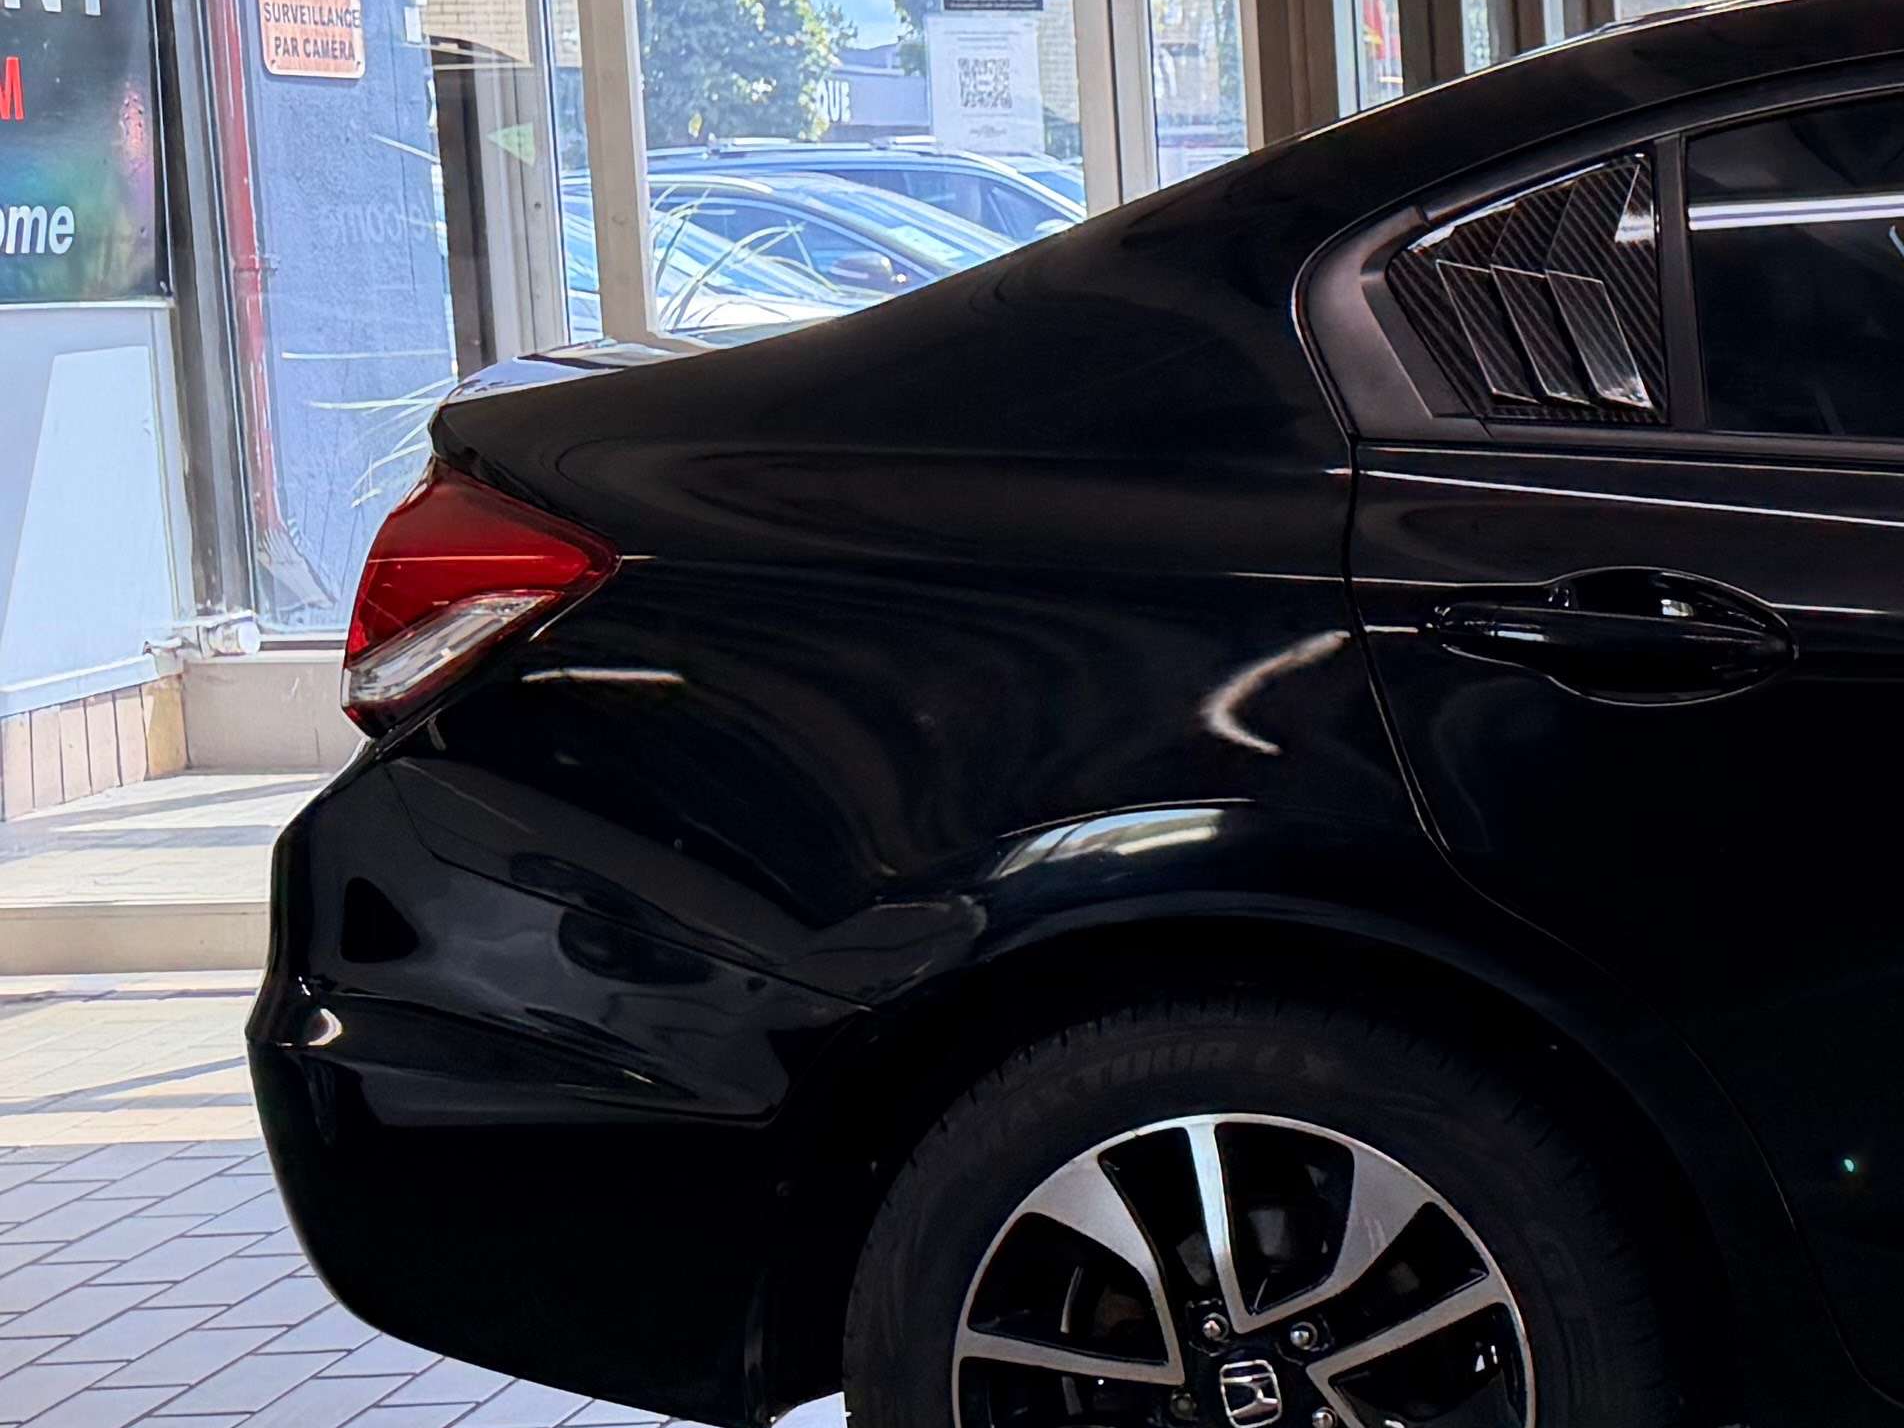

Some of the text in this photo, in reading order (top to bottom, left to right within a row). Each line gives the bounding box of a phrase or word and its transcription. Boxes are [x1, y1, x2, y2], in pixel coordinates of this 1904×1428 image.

[263, 2, 361, 28] SURVEILLANCE
[274, 37, 300, 57] PAR
[0, 204, 76, 256] me
